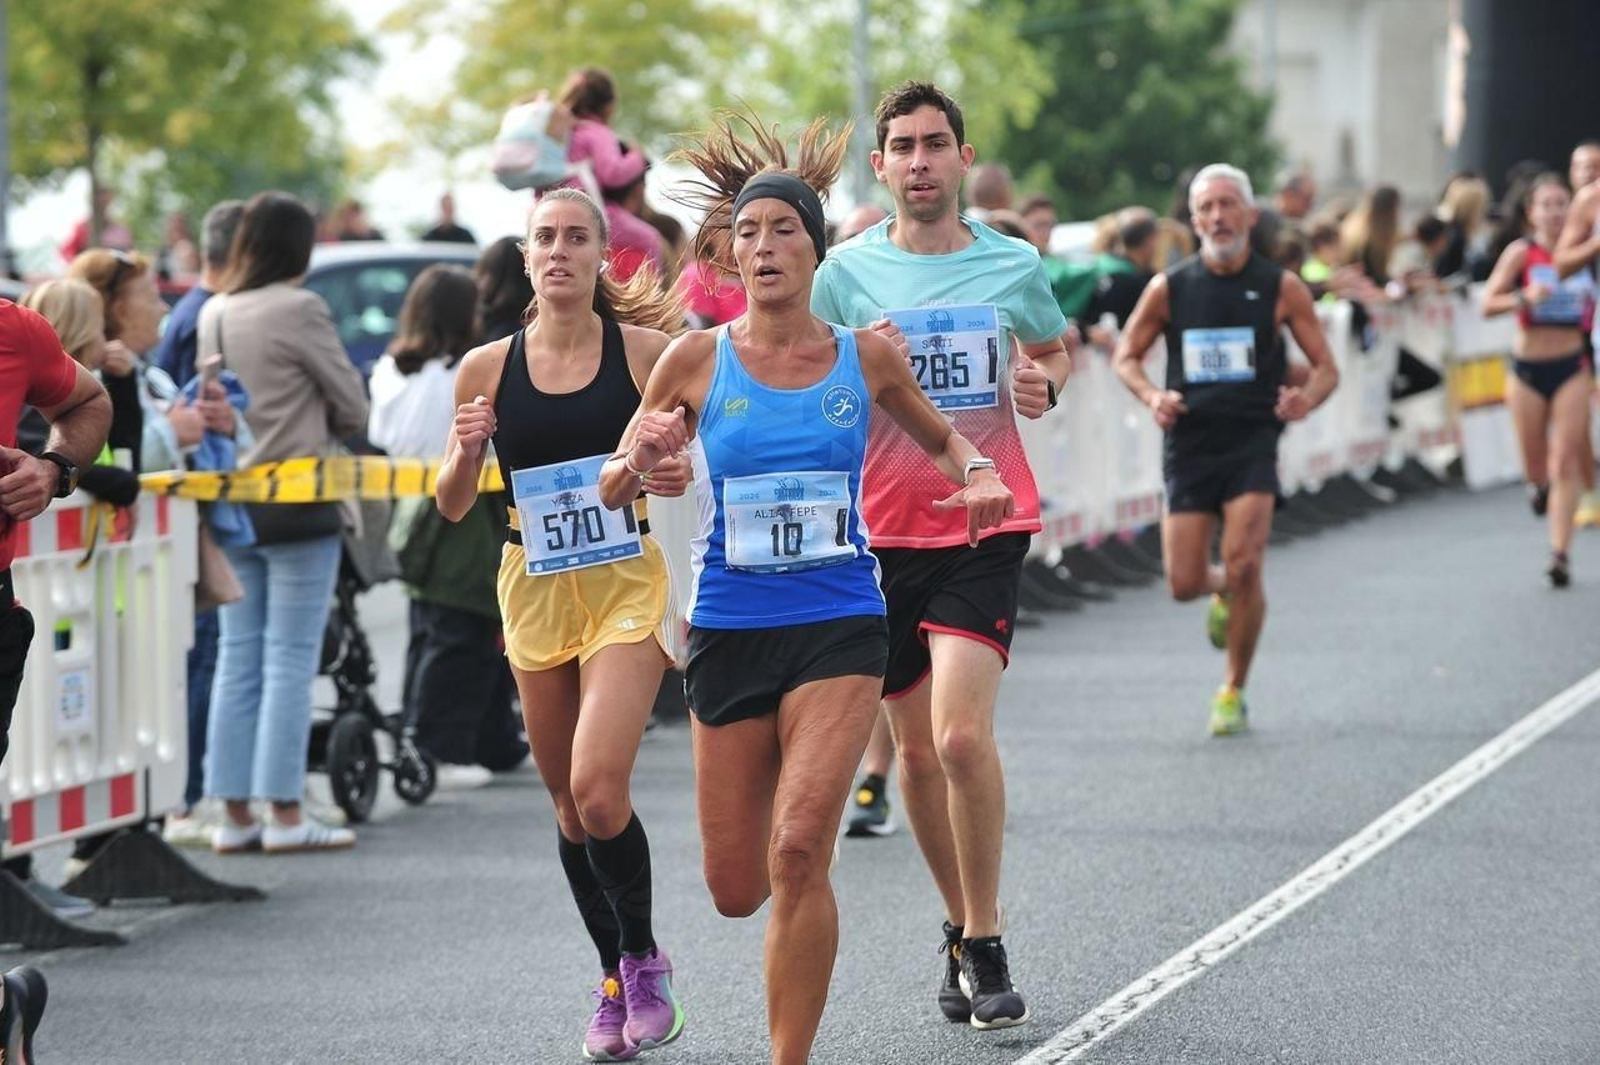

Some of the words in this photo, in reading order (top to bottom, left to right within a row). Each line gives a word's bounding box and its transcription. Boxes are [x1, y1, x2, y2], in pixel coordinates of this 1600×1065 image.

[921, 337, 953, 350] SANTI
[542, 505, 606, 551] 570
[770, 522, 803, 557] 10
